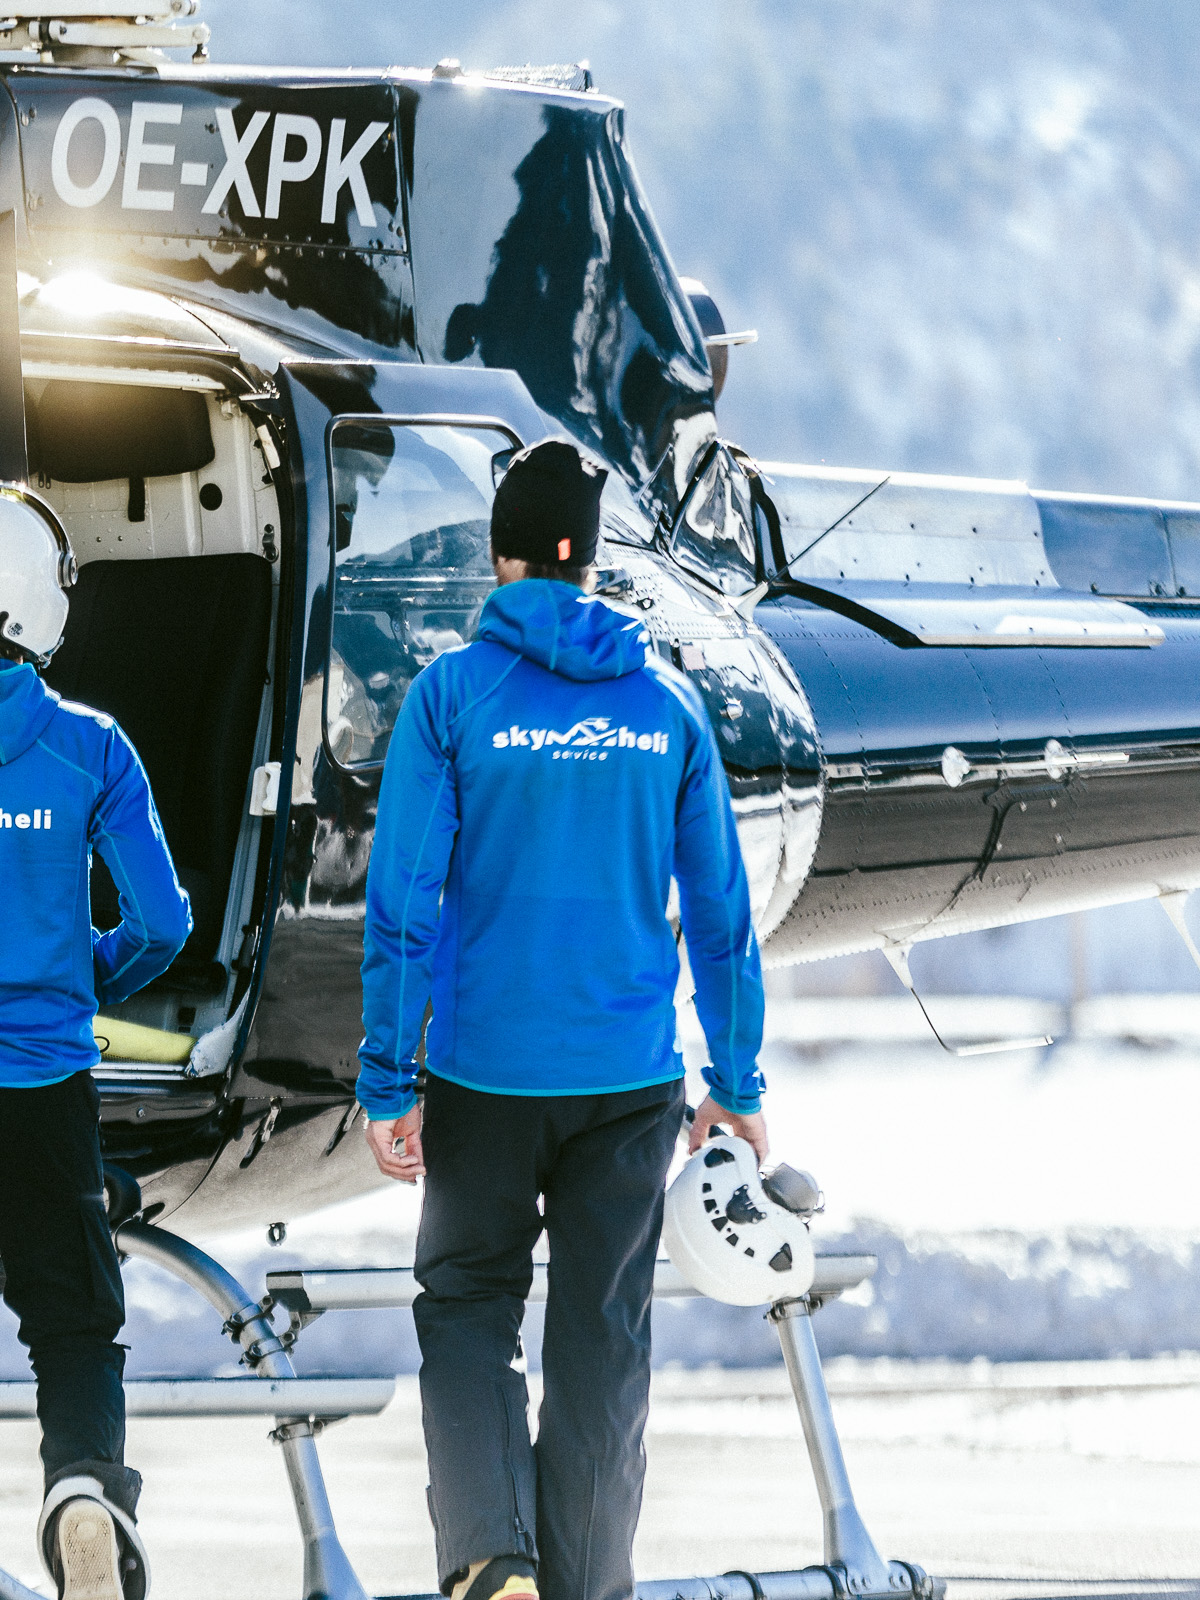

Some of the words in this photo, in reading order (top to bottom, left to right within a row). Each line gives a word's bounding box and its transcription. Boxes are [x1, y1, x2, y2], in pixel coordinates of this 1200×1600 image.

[51, 97, 390, 228] OE-XPK
[492, 725, 547, 751] sky
[618, 726, 669, 755] heli
